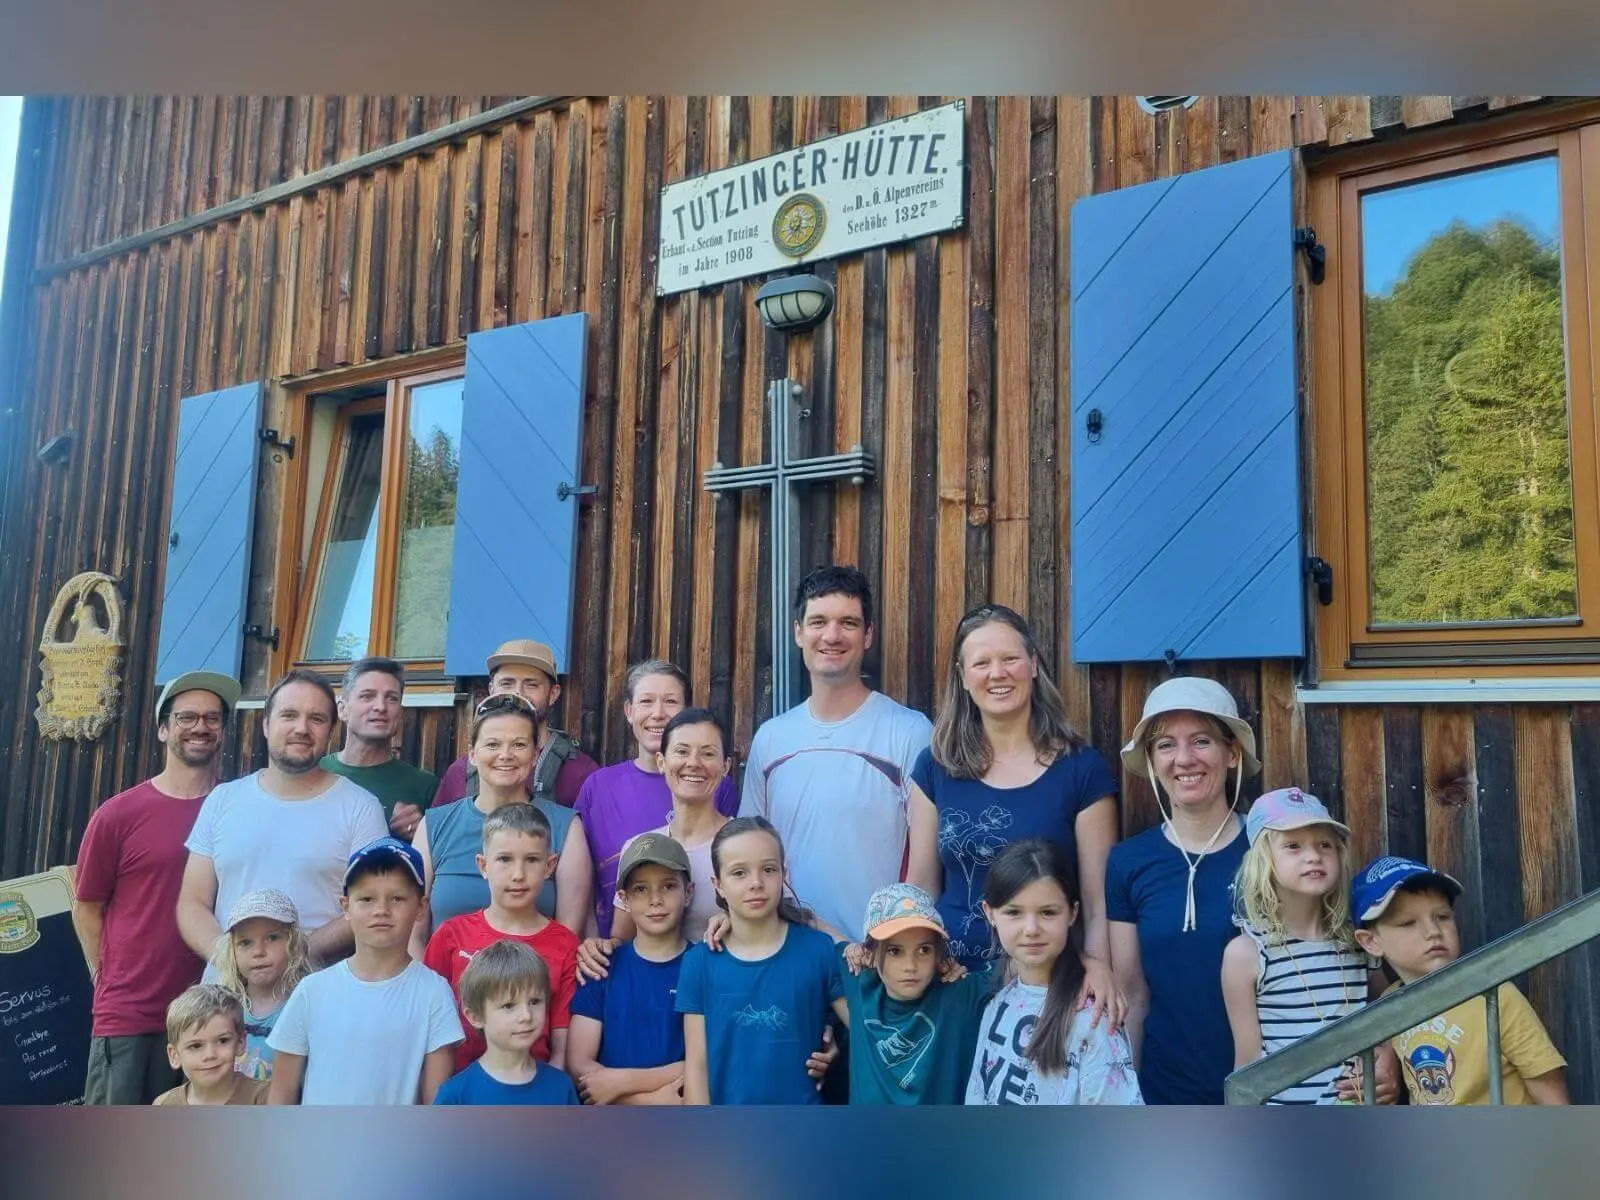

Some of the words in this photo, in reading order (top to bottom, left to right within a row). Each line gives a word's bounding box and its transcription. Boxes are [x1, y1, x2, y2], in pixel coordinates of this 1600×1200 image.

[672, 129, 948, 240] TUTZINGER-HÜTTE.
[884, 177, 944, 204] Alpenvereins
[847, 213, 888, 235] Seehöhe
[662, 243, 686, 259] Erbaut
[697, 235, 723, 251] Section
[727, 225, 759, 243] Tutzing
[679, 263, 689, 276] im
[694, 256, 719, 273] Jahre
[725, 246, 753, 265] 1908
[0, 985, 52, 1013] Servus
